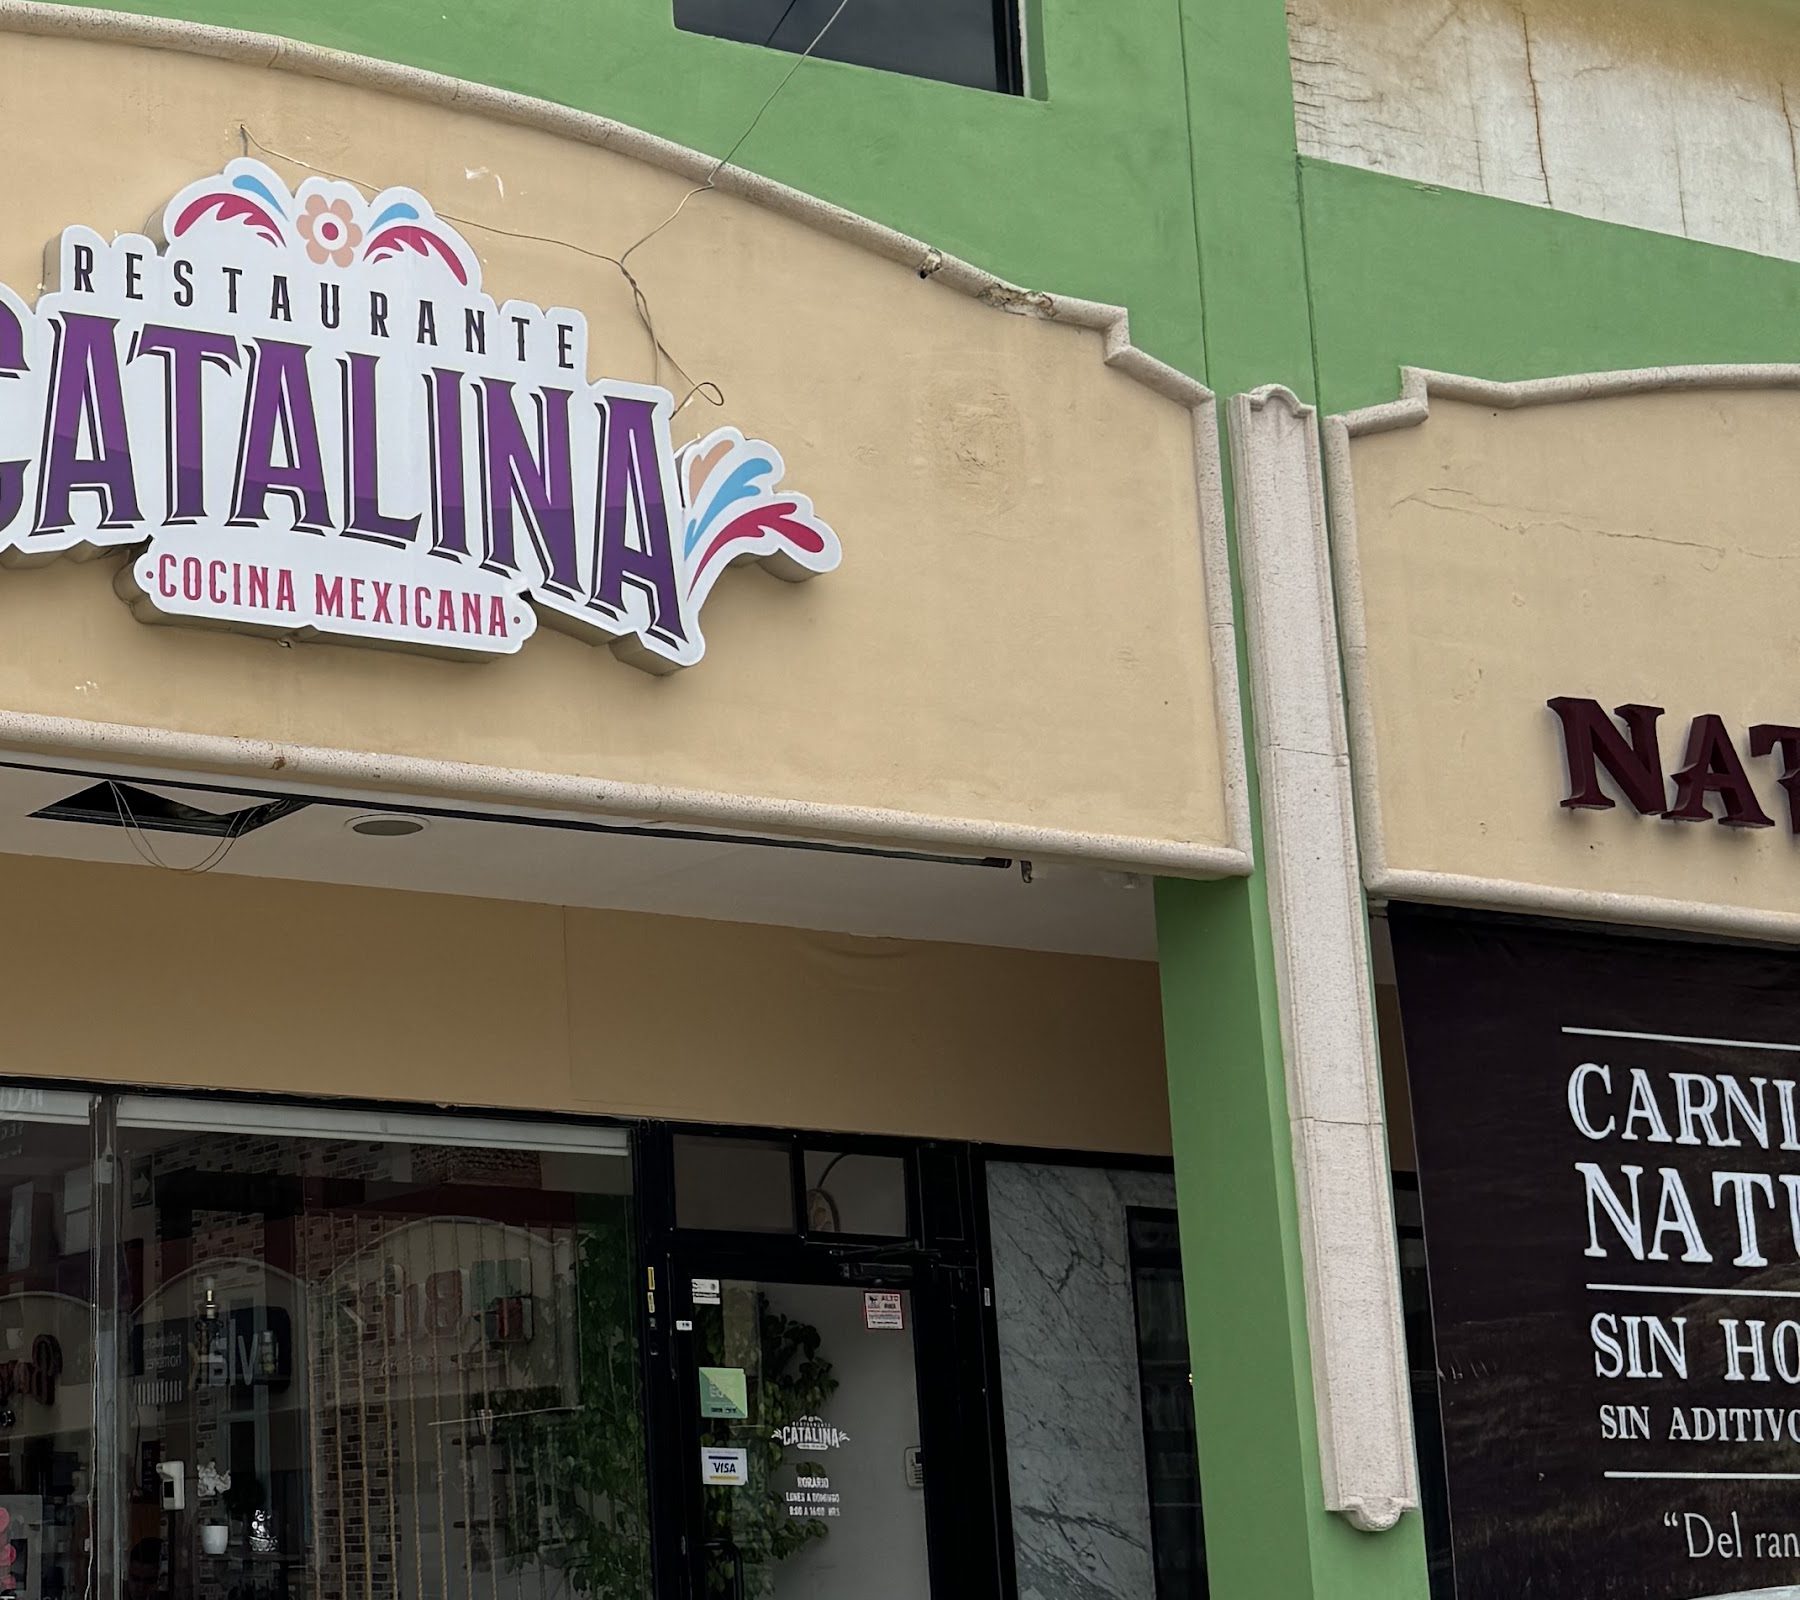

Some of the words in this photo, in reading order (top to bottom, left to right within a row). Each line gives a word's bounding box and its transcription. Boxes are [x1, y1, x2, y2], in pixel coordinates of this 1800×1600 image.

[74, 244, 576, 370] RESTAURANTE
[158, 553, 296, 612] COCINA
[314, 573, 508, 638] MEXICANA
[1567, 1062, 1800, 1151] CARNI
[1590, 1312, 1688, 1380] SIN
[1718, 1319, 1800, 1384] HO
[783, 1426, 840, 1448] CATALINA
[1600, 1404, 1650, 1440] SIN
[1668, 1406, 1800, 1443] ADITIVO
[712, 1462, 737, 1474] VISA
[1754, 1530, 1800, 1559] ran
